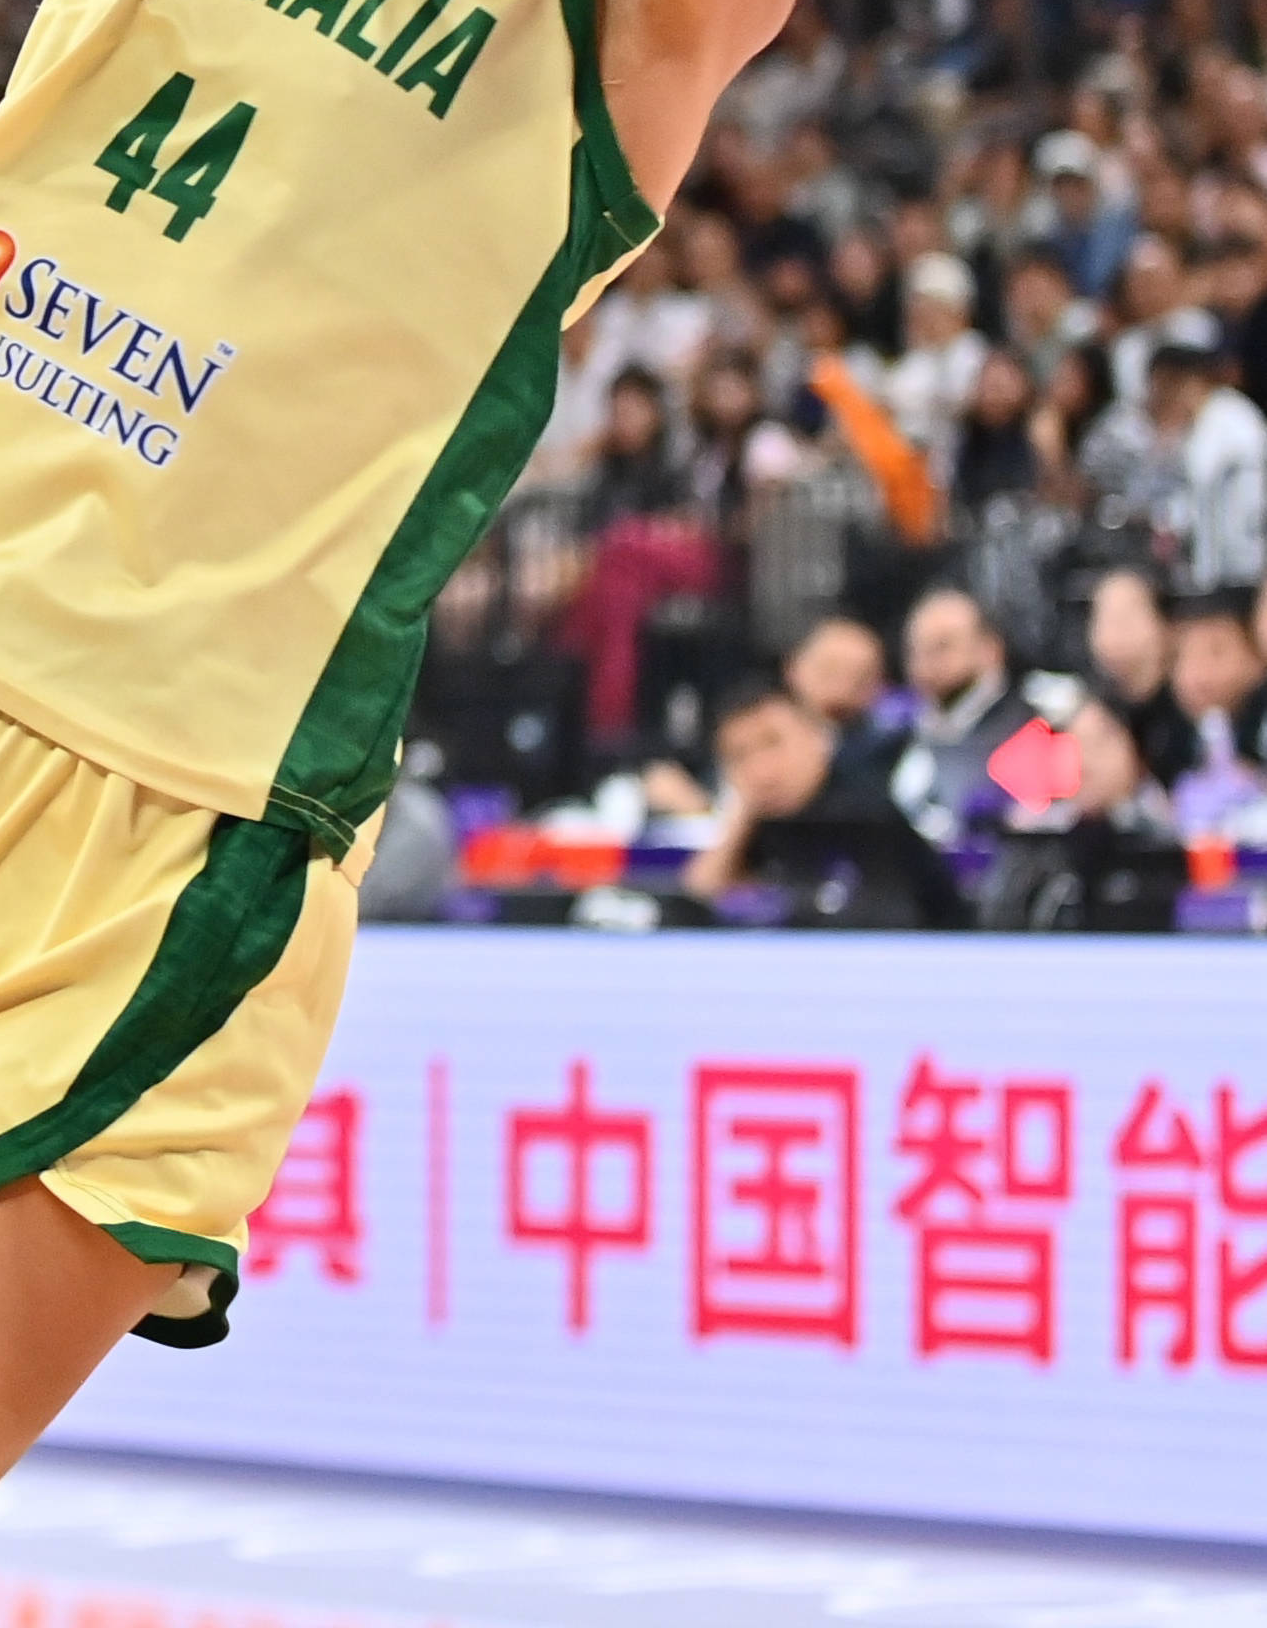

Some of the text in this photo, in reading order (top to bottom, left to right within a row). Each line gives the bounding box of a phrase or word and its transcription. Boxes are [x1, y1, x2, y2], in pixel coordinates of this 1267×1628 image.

[94, 71, 258, 244] 44
[4, 257, 224, 414] SEVEN
[505, 1056, 1267, 1368] 中国智能
